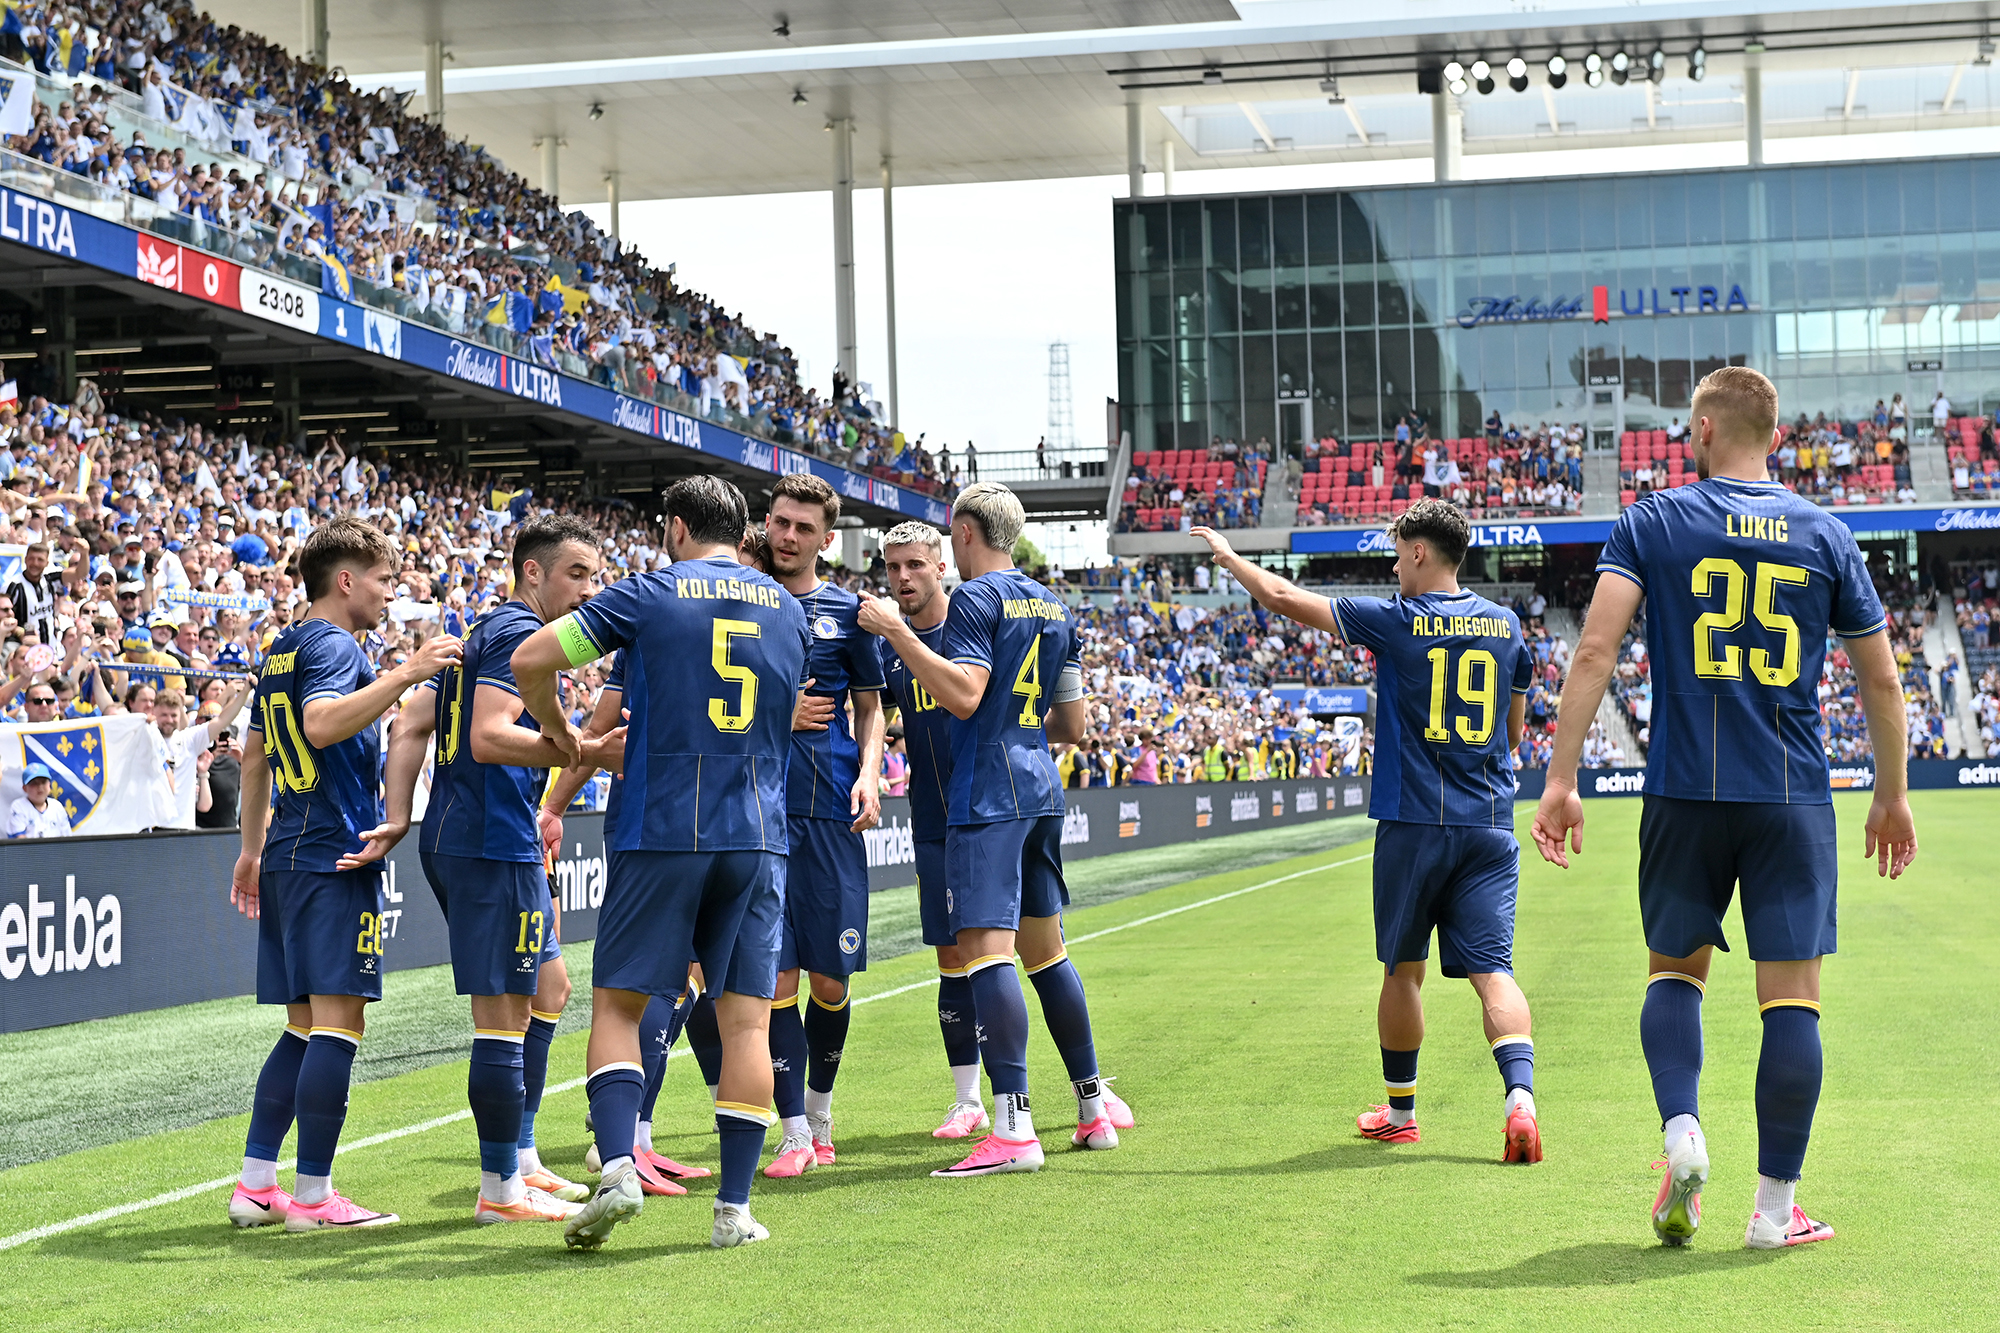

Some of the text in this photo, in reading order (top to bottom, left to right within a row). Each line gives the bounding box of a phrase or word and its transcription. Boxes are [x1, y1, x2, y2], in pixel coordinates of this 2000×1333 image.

[1, 189, 77, 257] LTRA
[203, 263, 348, 338] 0 23:08 1
[1621, 284, 1749, 315] ULTRA
[446, 339, 562, 407] Michelob ULTRA
[612, 394, 702, 449] Michelob ULTRA
[1726, 514, 1789, 543] LUKIĆ
[676, 576, 780, 609] KOLAŠINAC
[1691, 557, 1810, 687] 25
[568, 621, 588, 653] RESPECT
[1412, 615, 1511, 639] ALAJBEGOVIĆ
[707, 618, 761, 734] 5
[1012, 633, 1042, 729] 4
[1317, 693, 1354, 707] Together
[1424, 647, 1498, 745] 19
[0, 874, 122, 981] et.ba
[515, 911, 544, 953] 13
